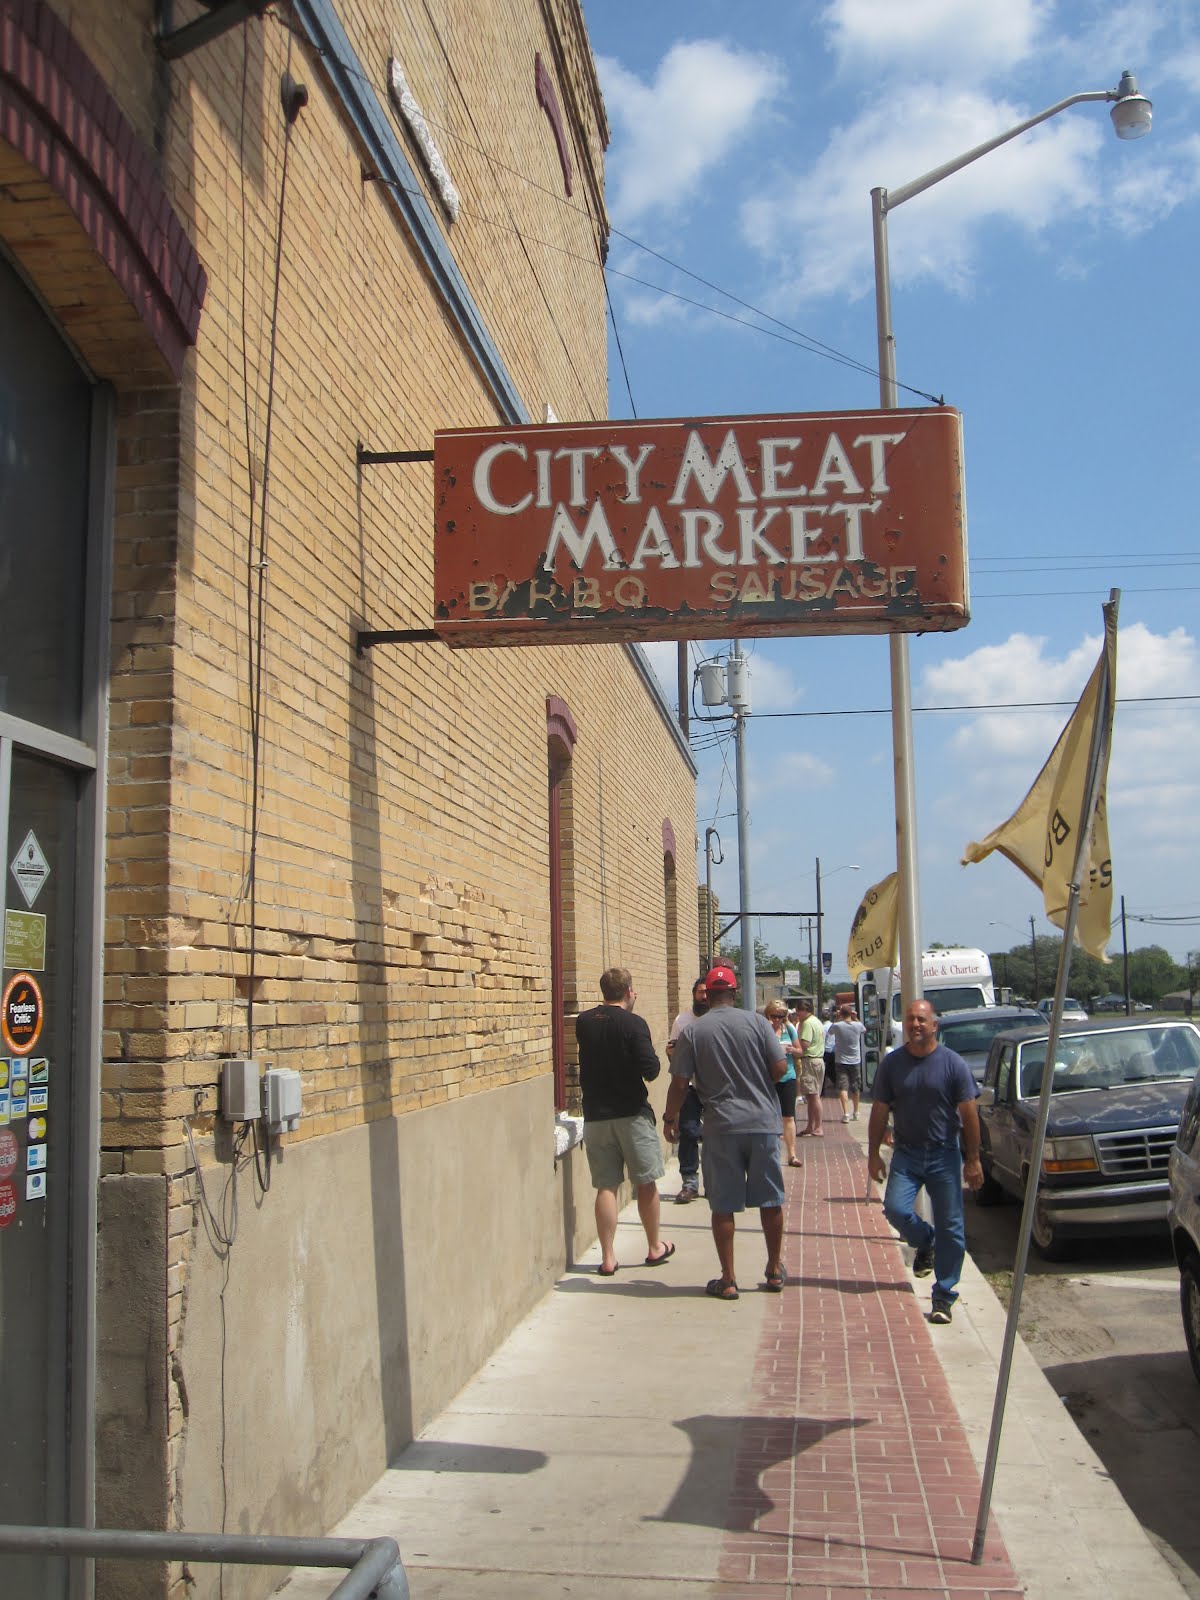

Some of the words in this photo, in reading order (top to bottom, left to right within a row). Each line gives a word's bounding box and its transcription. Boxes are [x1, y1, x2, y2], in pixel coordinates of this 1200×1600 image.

[472, 441, 656, 515] CITY
[668, 428, 907, 506] MEAT
[543, 499, 882, 571] MARKET
[710, 565, 917, 602] SAUSAGE
[949, 964, 979, 975] Charter
[9, 1003, 36, 1014] Fearless
[14, 1013, 31, 1024] Critic
[32, 1095, 45, 1104] VISA
